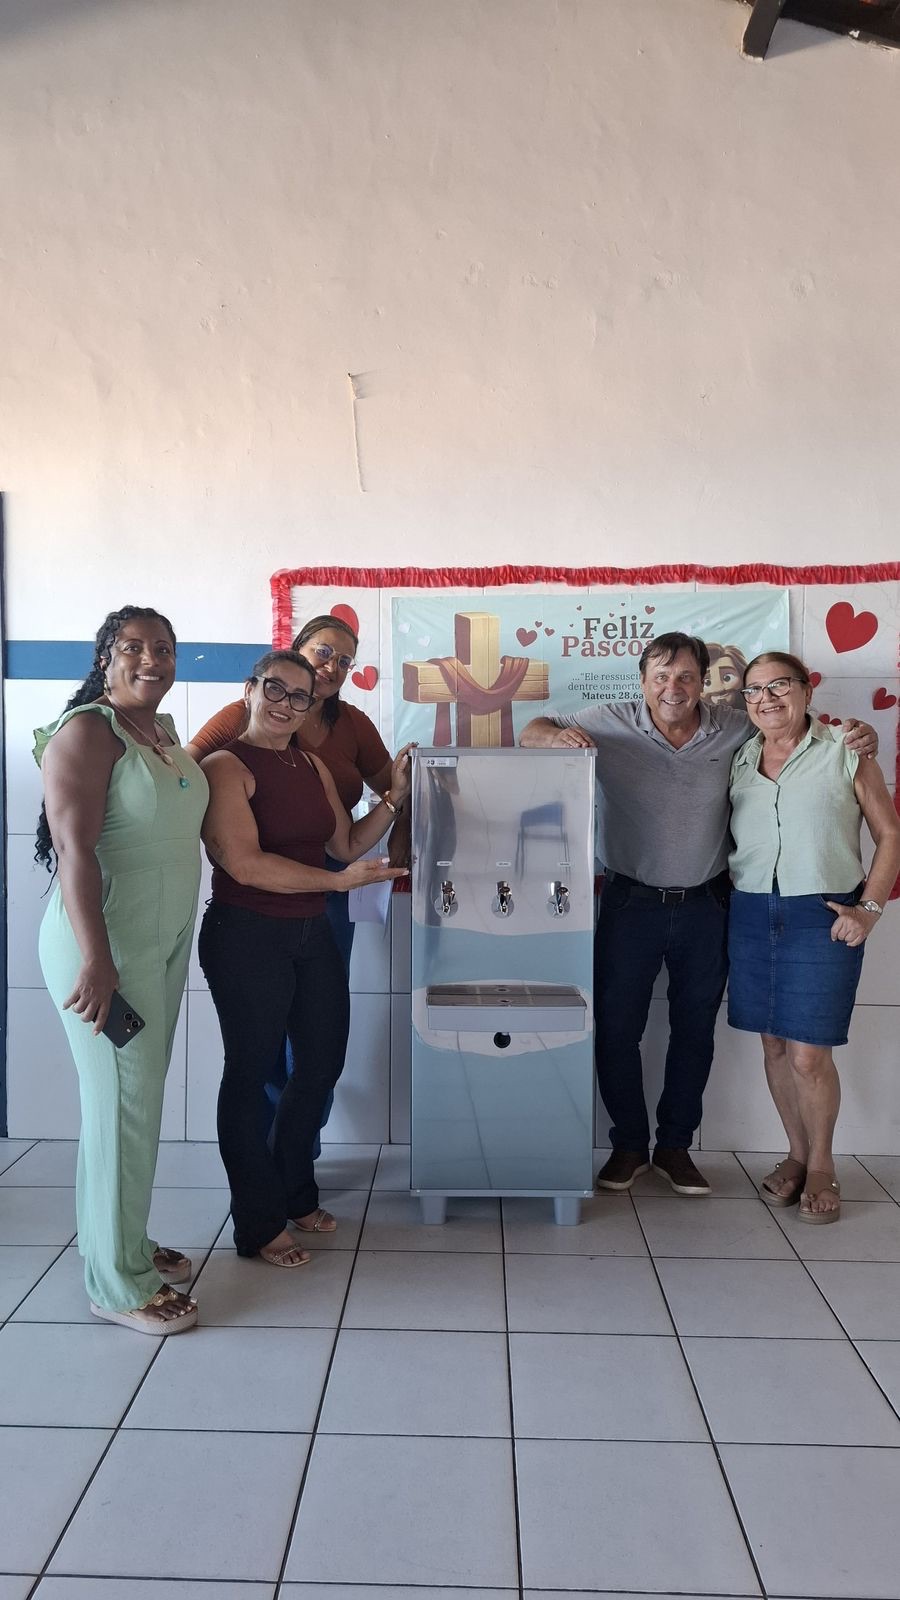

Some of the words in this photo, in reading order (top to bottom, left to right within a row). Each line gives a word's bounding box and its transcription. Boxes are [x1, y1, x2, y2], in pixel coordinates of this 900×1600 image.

[583, 615, 655, 640] Feliz
[567, 682, 598, 691] dentre
[600, 683, 611, 691] os
[582, 691, 616, 700] Mateus
[618, 691, 644, 700] 28.6a
